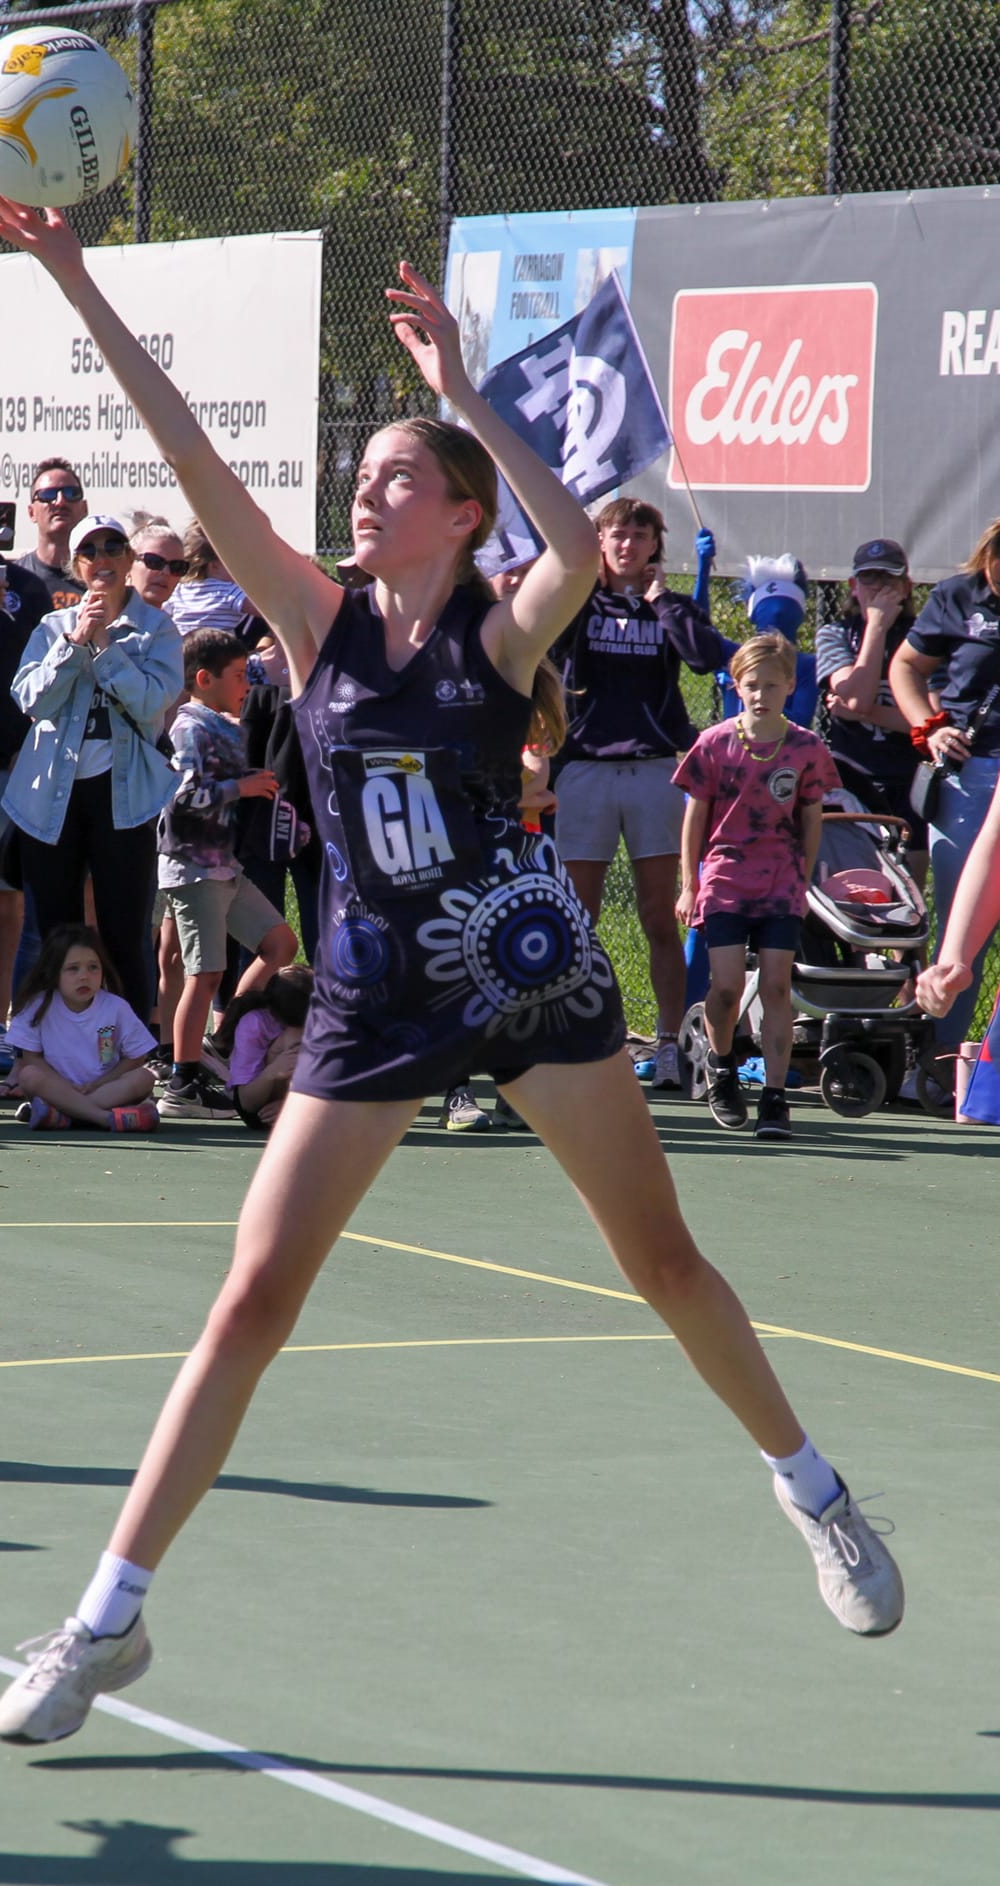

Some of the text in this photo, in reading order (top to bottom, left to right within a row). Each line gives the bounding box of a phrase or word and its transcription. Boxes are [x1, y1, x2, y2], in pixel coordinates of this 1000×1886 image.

[512, 254, 565, 282] YARRAGON
[510, 291, 560, 320] FOOTBALL
[686, 330, 857, 445] Elders
[33, 396, 91, 432] Princes
[587, 615, 664, 644] CATANI
[588, 640, 658, 656] FOOTBALL CLUB
[361, 776, 455, 876] GA
[391, 873, 417, 886] ROYAL
[418, 866, 443, 881] HOTEL
